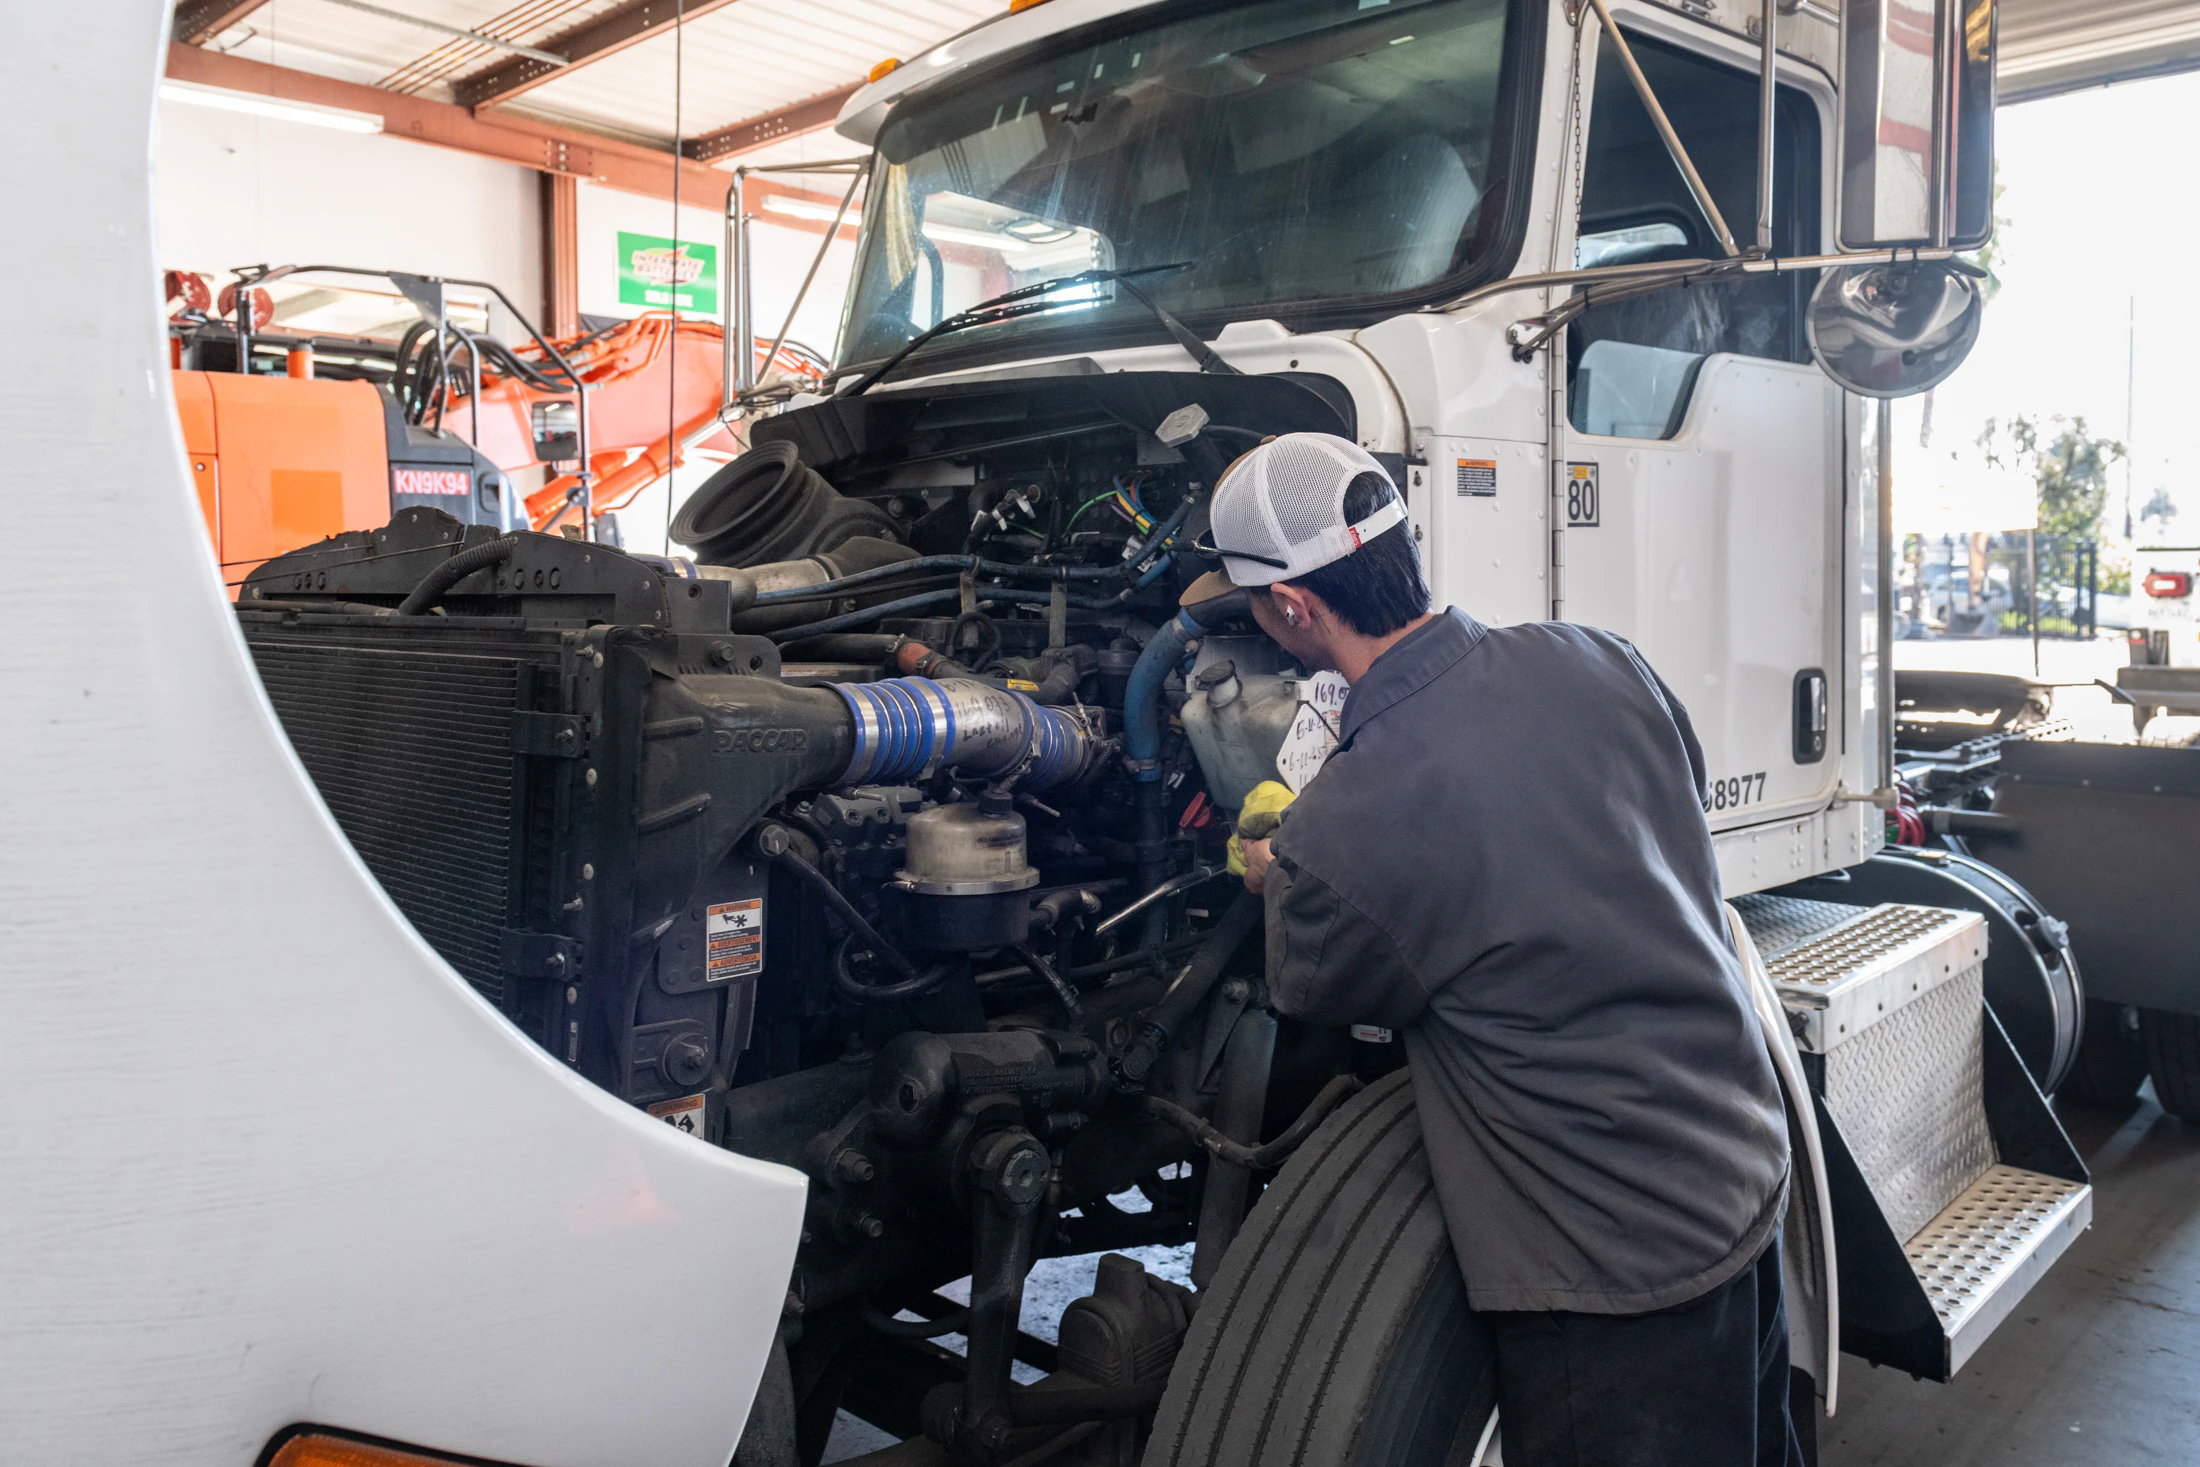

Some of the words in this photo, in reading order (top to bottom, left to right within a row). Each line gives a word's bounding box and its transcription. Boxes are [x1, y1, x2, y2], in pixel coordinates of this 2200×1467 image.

[396, 470, 468, 495] KN9K94
[1568, 480, 1594, 521] 80
[713, 729, 806, 753] PACCAR
[726, 902, 751, 912] WARNING
[718, 936, 759, 948] AVERTISSEMENT
